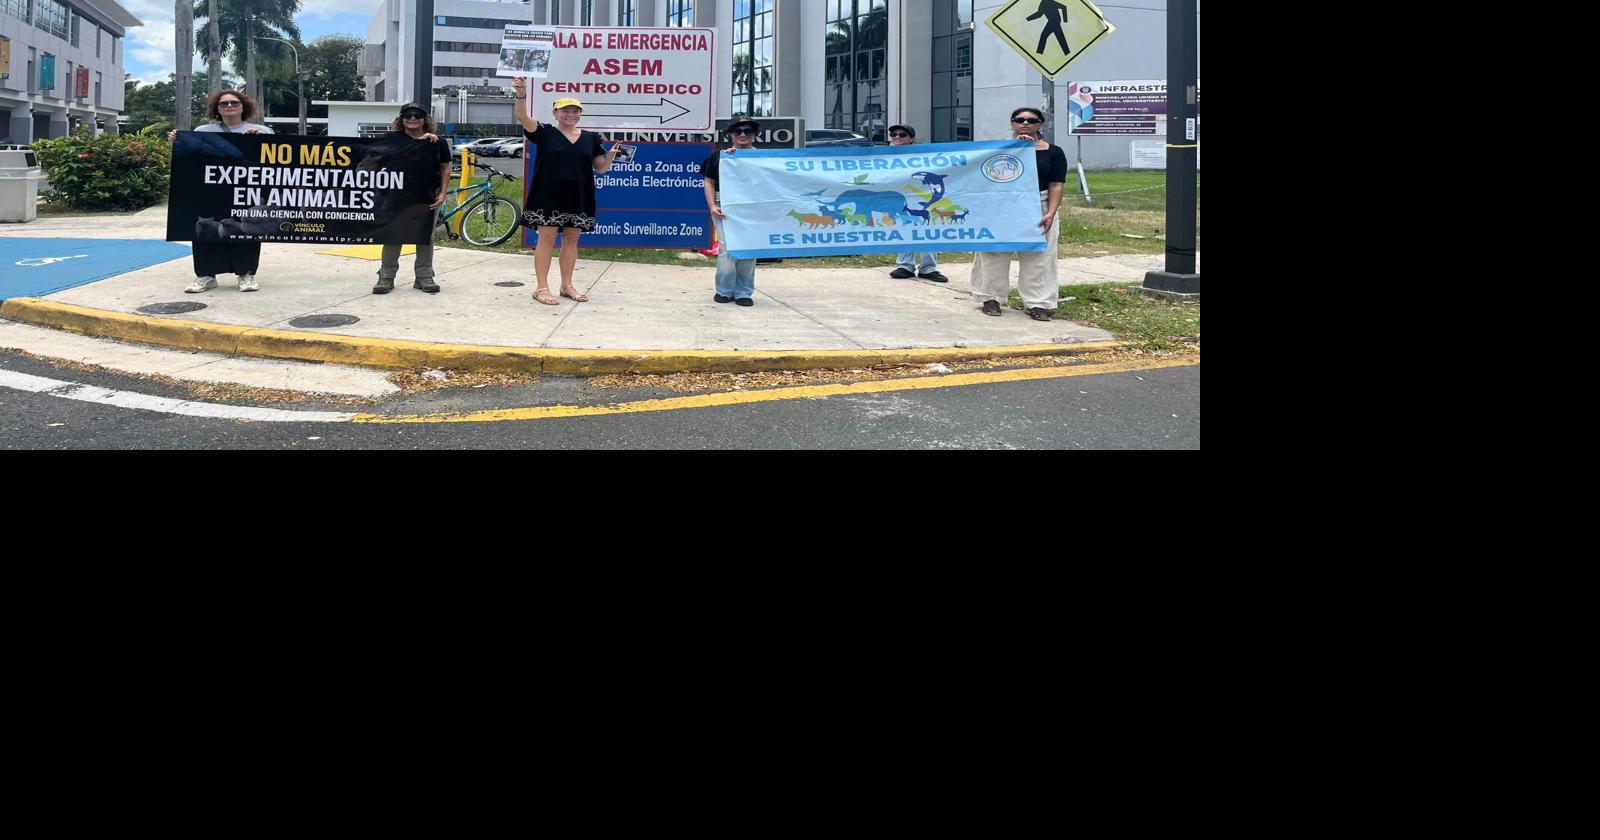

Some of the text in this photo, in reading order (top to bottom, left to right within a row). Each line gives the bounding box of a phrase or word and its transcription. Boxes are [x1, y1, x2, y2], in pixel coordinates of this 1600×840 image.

[552, 32, 578, 48] ALA
[583, 33, 602, 49] DE
[607, 33, 708, 51] EMERGENCIA
[583, 58, 662, 76] ASEM
[541, 82, 702, 95] CENTRO MEDICO
[260, 141, 351, 167] NO MÁS
[784, 159, 815, 173] SU
[821, 153, 968, 172] LIBERACIÓN
[607, 160, 701, 173] rando a Zona de
[204, 165, 405, 190] EXPERIMENTACIÓN
[593, 175, 704, 189] igilancia Electrónica
[233, 187, 375, 210] EN ANIMALES
[231, 208, 375, 221] POR UNA CIENCIA CON CONCIENCIA
[580, 222, 703, 236] tronic Surveillance Zone
[769, 226, 995, 246] ES NUESTRA LUCHA
[230, 234, 374, 243] www.vinculoanimalpr.org
